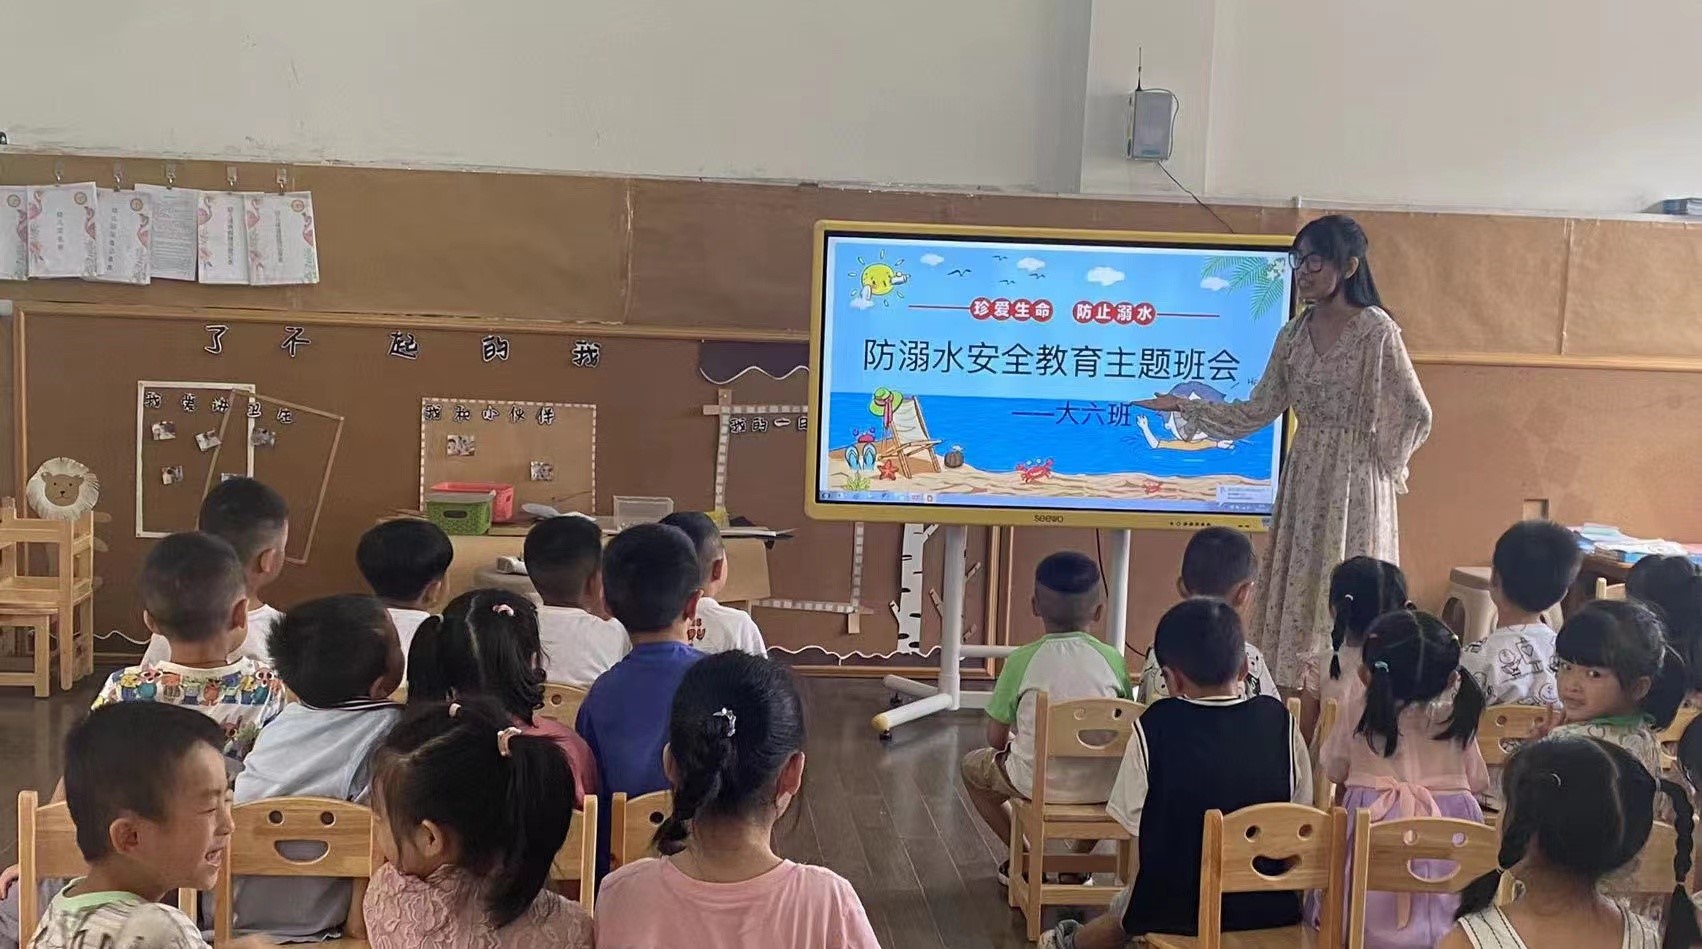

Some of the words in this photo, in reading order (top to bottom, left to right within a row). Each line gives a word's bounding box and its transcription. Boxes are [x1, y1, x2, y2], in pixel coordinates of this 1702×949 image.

[973, 299, 1051, 319] 珍爱生命
[1076, 303, 1153, 322] 防止溺水
[203, 324, 602, 369] 了不起的我
[863, 337, 1241, 383] 防溺水安全教育主题班会
[424, 402, 555, 425] 我和小伙伴
